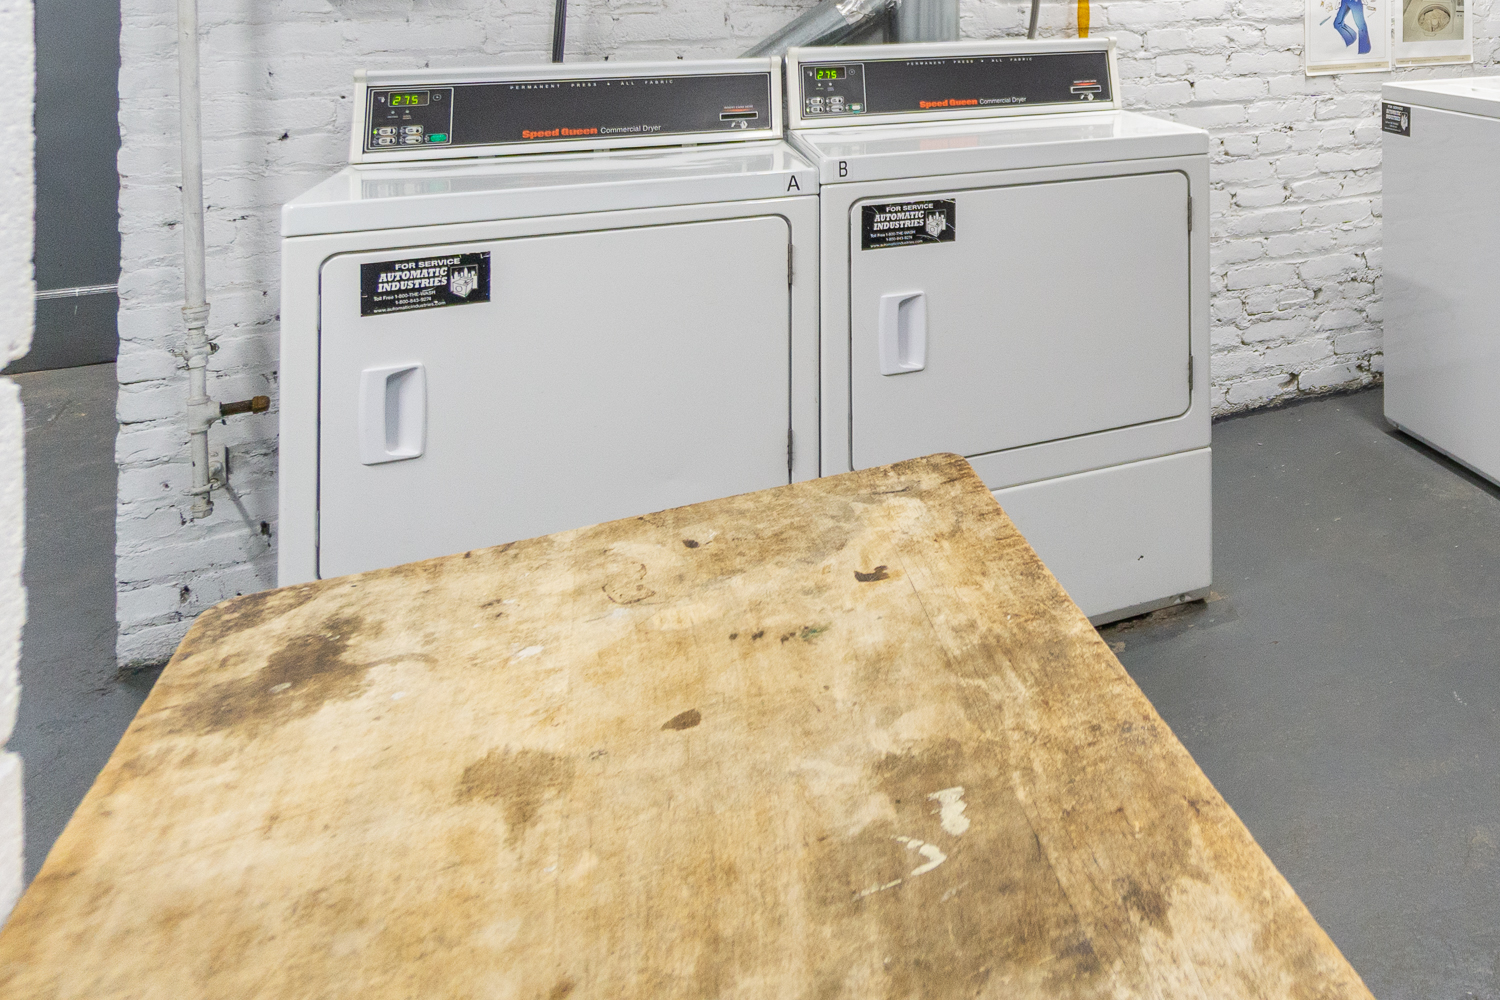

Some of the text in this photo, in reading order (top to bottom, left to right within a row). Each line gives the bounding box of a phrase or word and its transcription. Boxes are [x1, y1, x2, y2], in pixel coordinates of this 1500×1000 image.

[920, 100, 948, 109] Speed
[949, 98, 978, 106] Queen
[980, 97, 1012, 105] Commercial
[522, 124, 662, 140] Speed Queen Commercial Dryer
[838, 161, 848, 178] B
[787, 175, 800, 192] A
[902, 203, 934, 211] SERVICE
[874, 210, 924, 222] AUTOMATIC
[874, 219, 924, 230] INDUSTRIES
[395, 258, 460, 270] FOR SERVICE
[379, 266, 448, 282] AUTOMATIC
[378, 276, 448, 292] INDUSTRIES
[395, 290, 436, 299] 1-800-THE-WASH
[374, 301, 446, 314] www.automaticindustries.com
